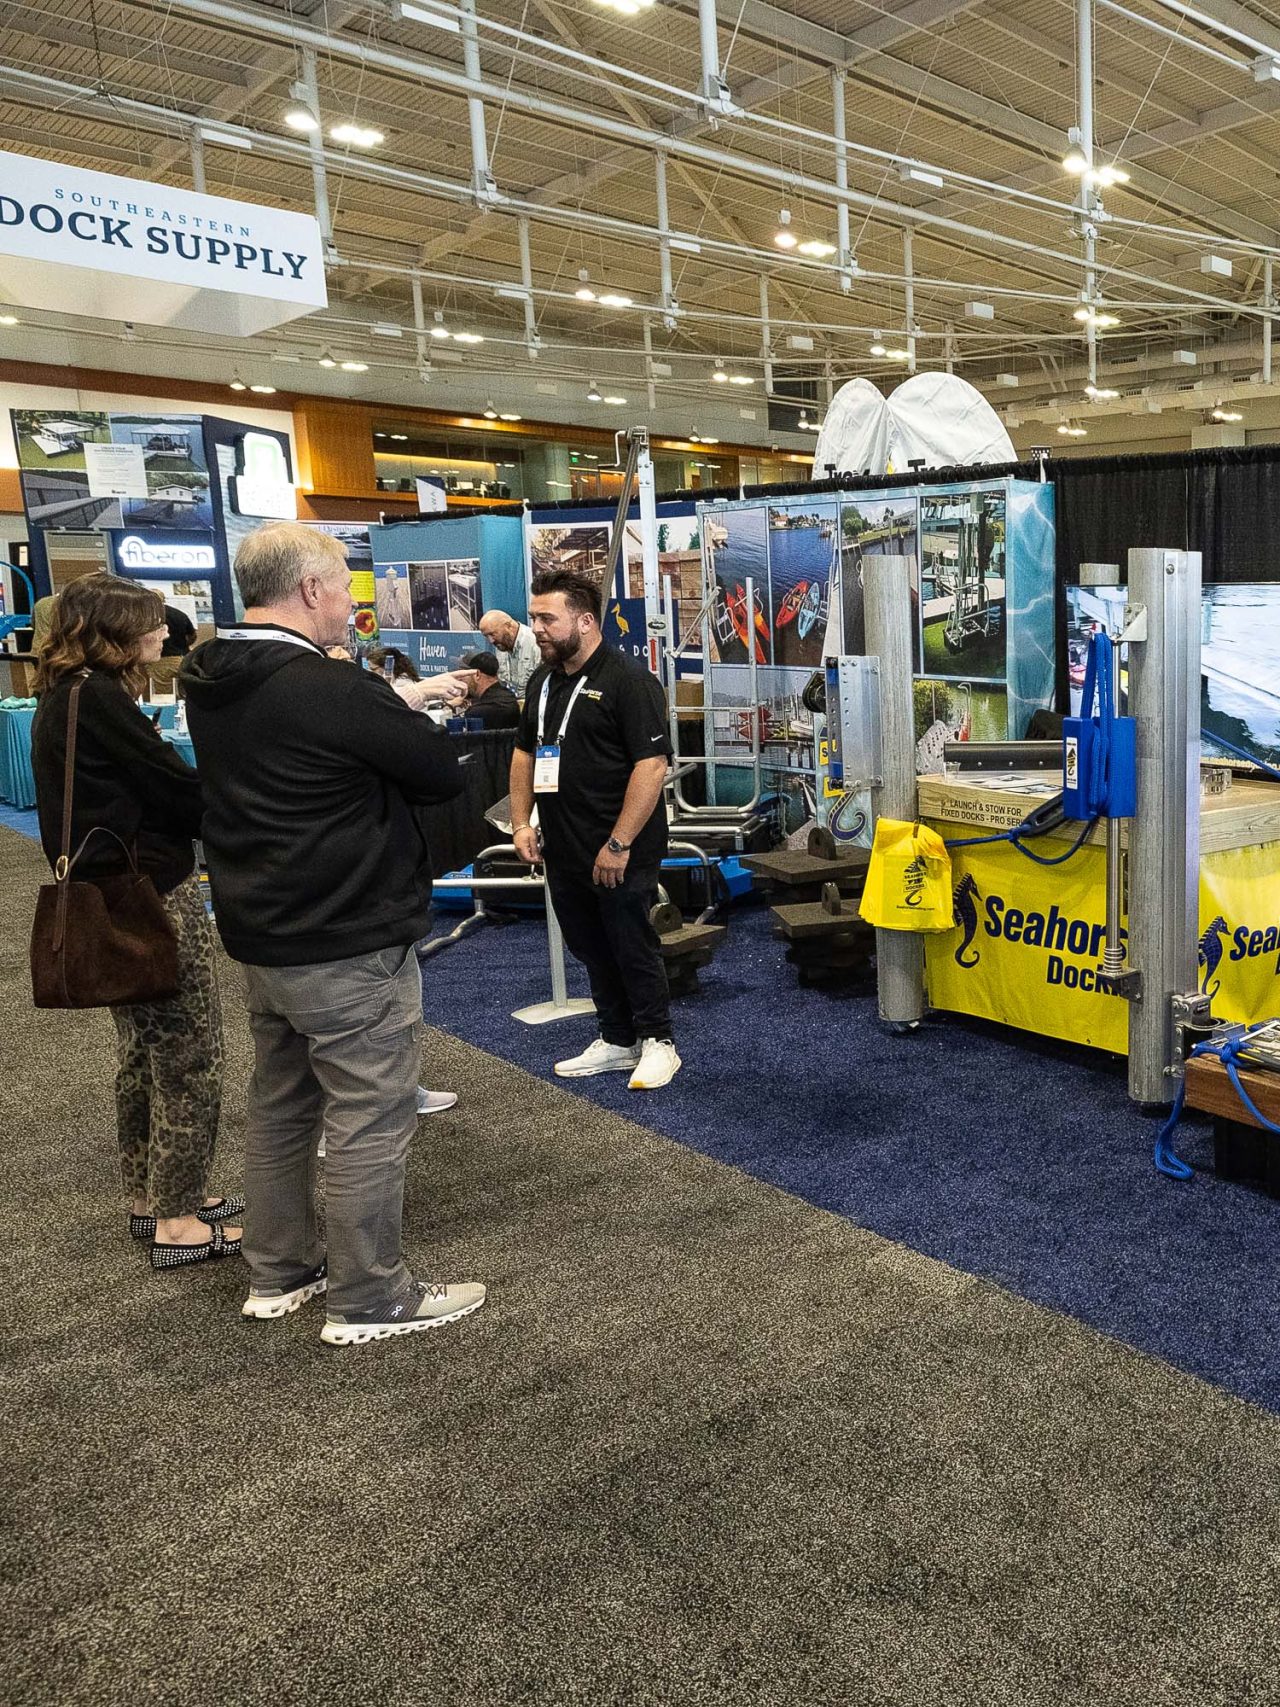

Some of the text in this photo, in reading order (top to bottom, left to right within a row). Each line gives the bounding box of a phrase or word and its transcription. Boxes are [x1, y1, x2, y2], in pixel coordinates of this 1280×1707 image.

[55, 188, 251, 237] SOUTHEASTERN
[0, 195, 308, 280] DOCK SUPPLY
[125, 538, 210, 565] fiberon
[419, 636, 448, 661] Haven
[940, 808, 960, 819] FIXED
[961, 811, 985, 822] DOCKS
[990, 815, 1005, 826] PRO
[950, 800, 1022, 817] LAUNCH & STOW FOR
